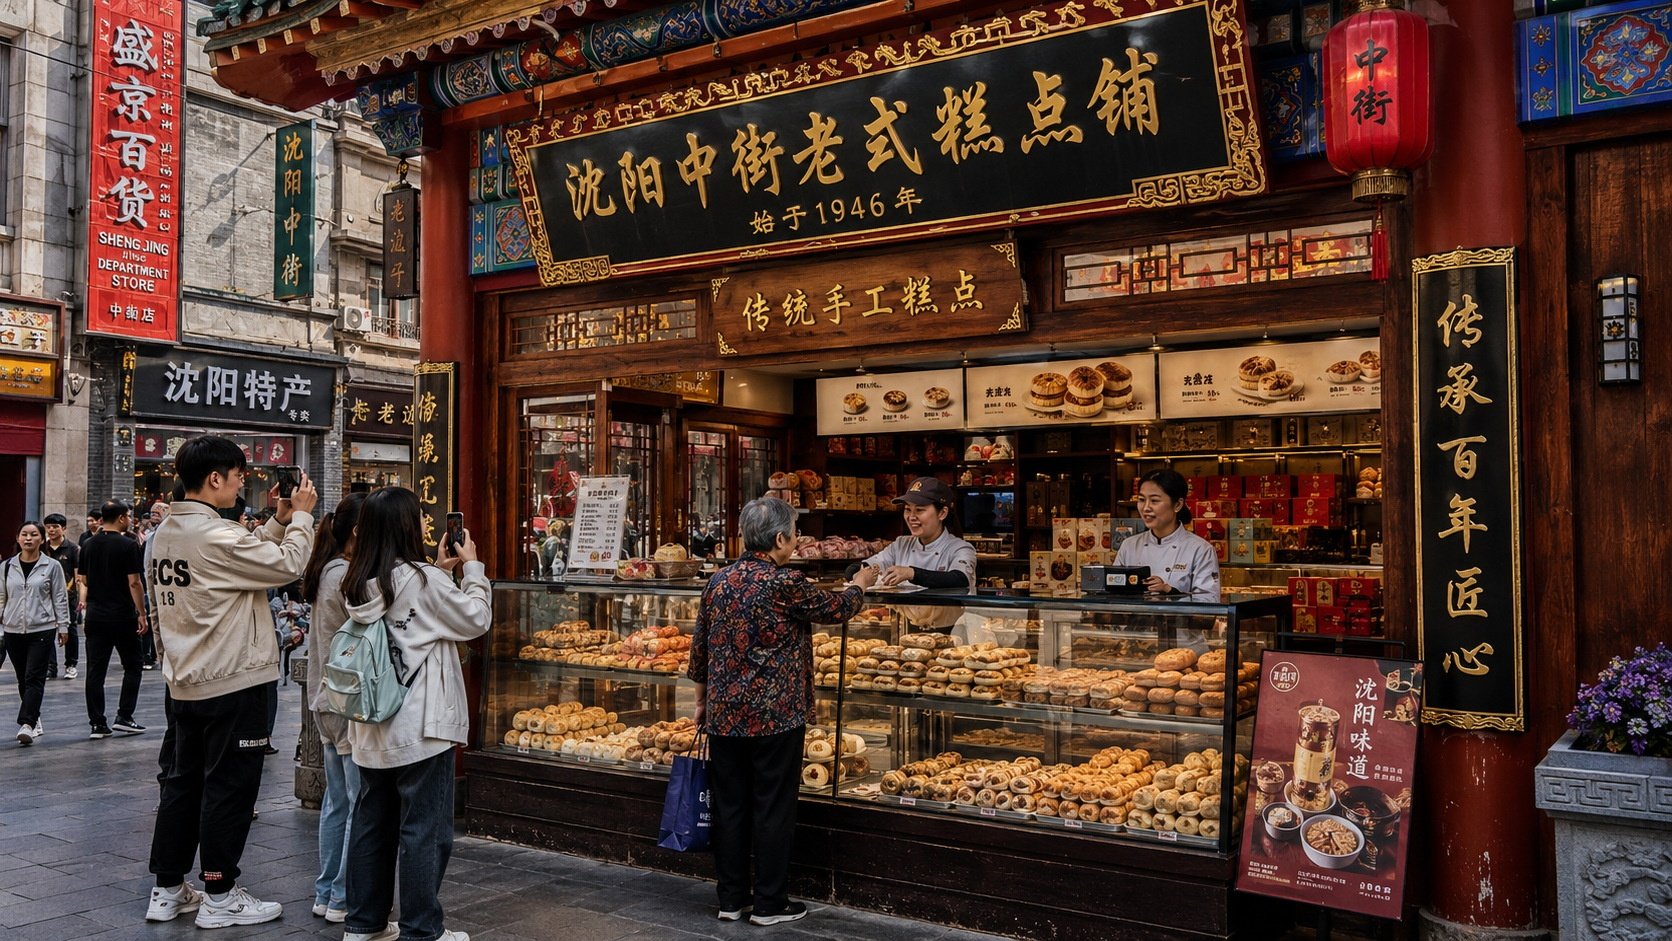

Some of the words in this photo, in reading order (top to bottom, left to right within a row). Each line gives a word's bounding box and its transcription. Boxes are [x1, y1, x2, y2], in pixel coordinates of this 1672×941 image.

[1351, 39, 1393, 125] 中街
[108, 18, 159, 230] 盛京百货
[565, 47, 1160, 221] 沈阳中街老式糕点铺
[99, 232, 141, 250] SHENG
[143, 240, 169, 255] JING
[750, 186, 923, 236] 始于1946年
[98, 257, 169, 280] DEPARTMENT
[112, 274, 155, 291] STORE
[742, 269, 985, 334] 传统手工糕点
[164, 361, 312, 412] 沈阳特产
[1437, 294, 1494, 676] 传承百年匠心
[1346, 677, 1378, 780] 沈阳味道
